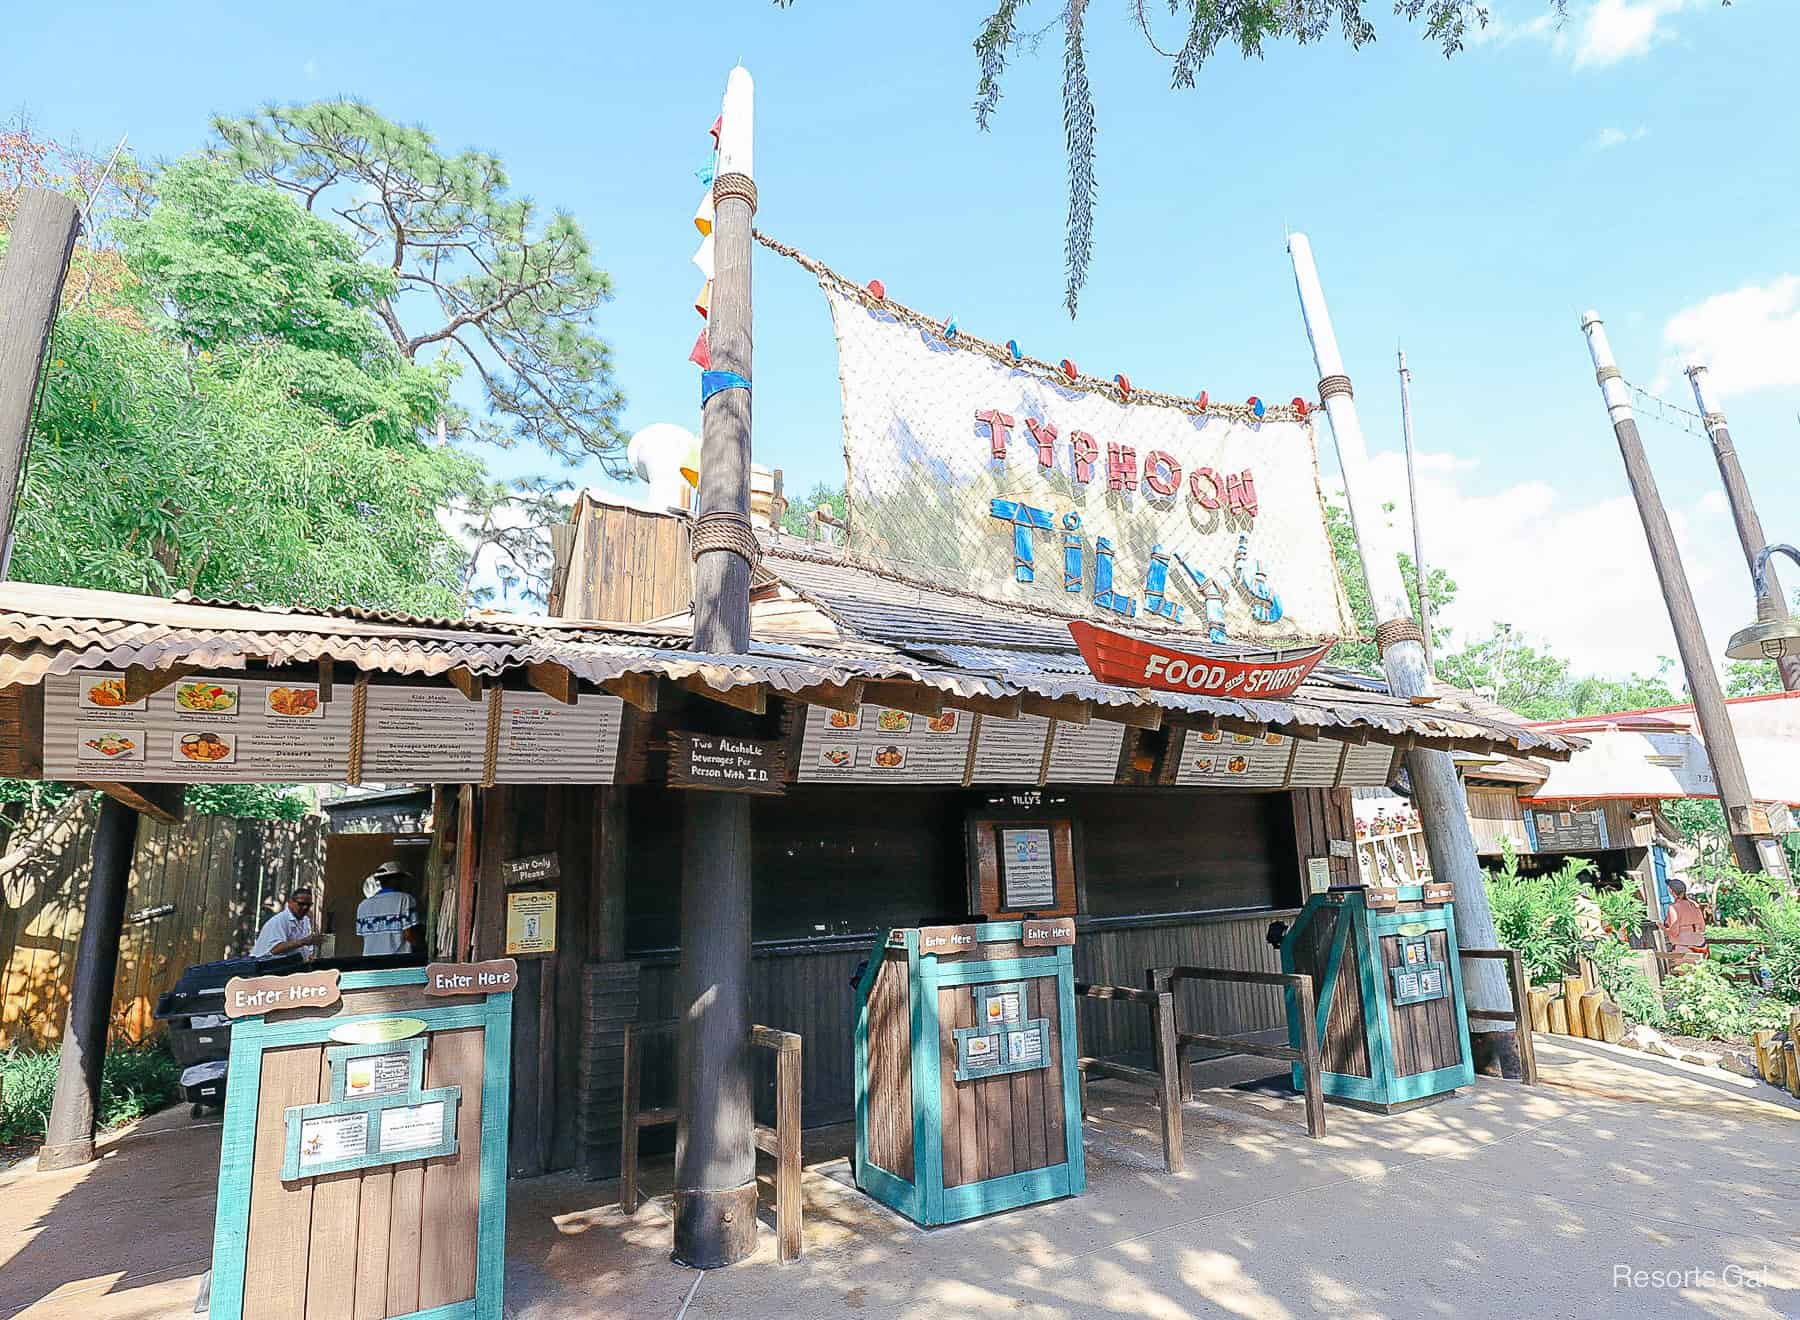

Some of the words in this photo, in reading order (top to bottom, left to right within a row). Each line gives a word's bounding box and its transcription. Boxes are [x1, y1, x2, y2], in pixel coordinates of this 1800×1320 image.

[974, 408, 1258, 518] TYPHOON
[1143, 653, 1227, 689] FOOD
[1224, 670, 1246, 693] and
[1243, 663, 1306, 693] SPIRITS
[691, 737, 713, 749] Two
[747, 768, 769, 782] I.D.
[531, 857, 551, 869] Only
[950, 933, 972, 944] Here
[1028, 928, 1049, 940] Enter
[1052, 926, 1072, 938] Here
[435, 973, 473, 990] Enter
[478, 971, 511, 986] Here
[235, 988, 282, 1008] Enter
[289, 984, 328, 1001] Here
